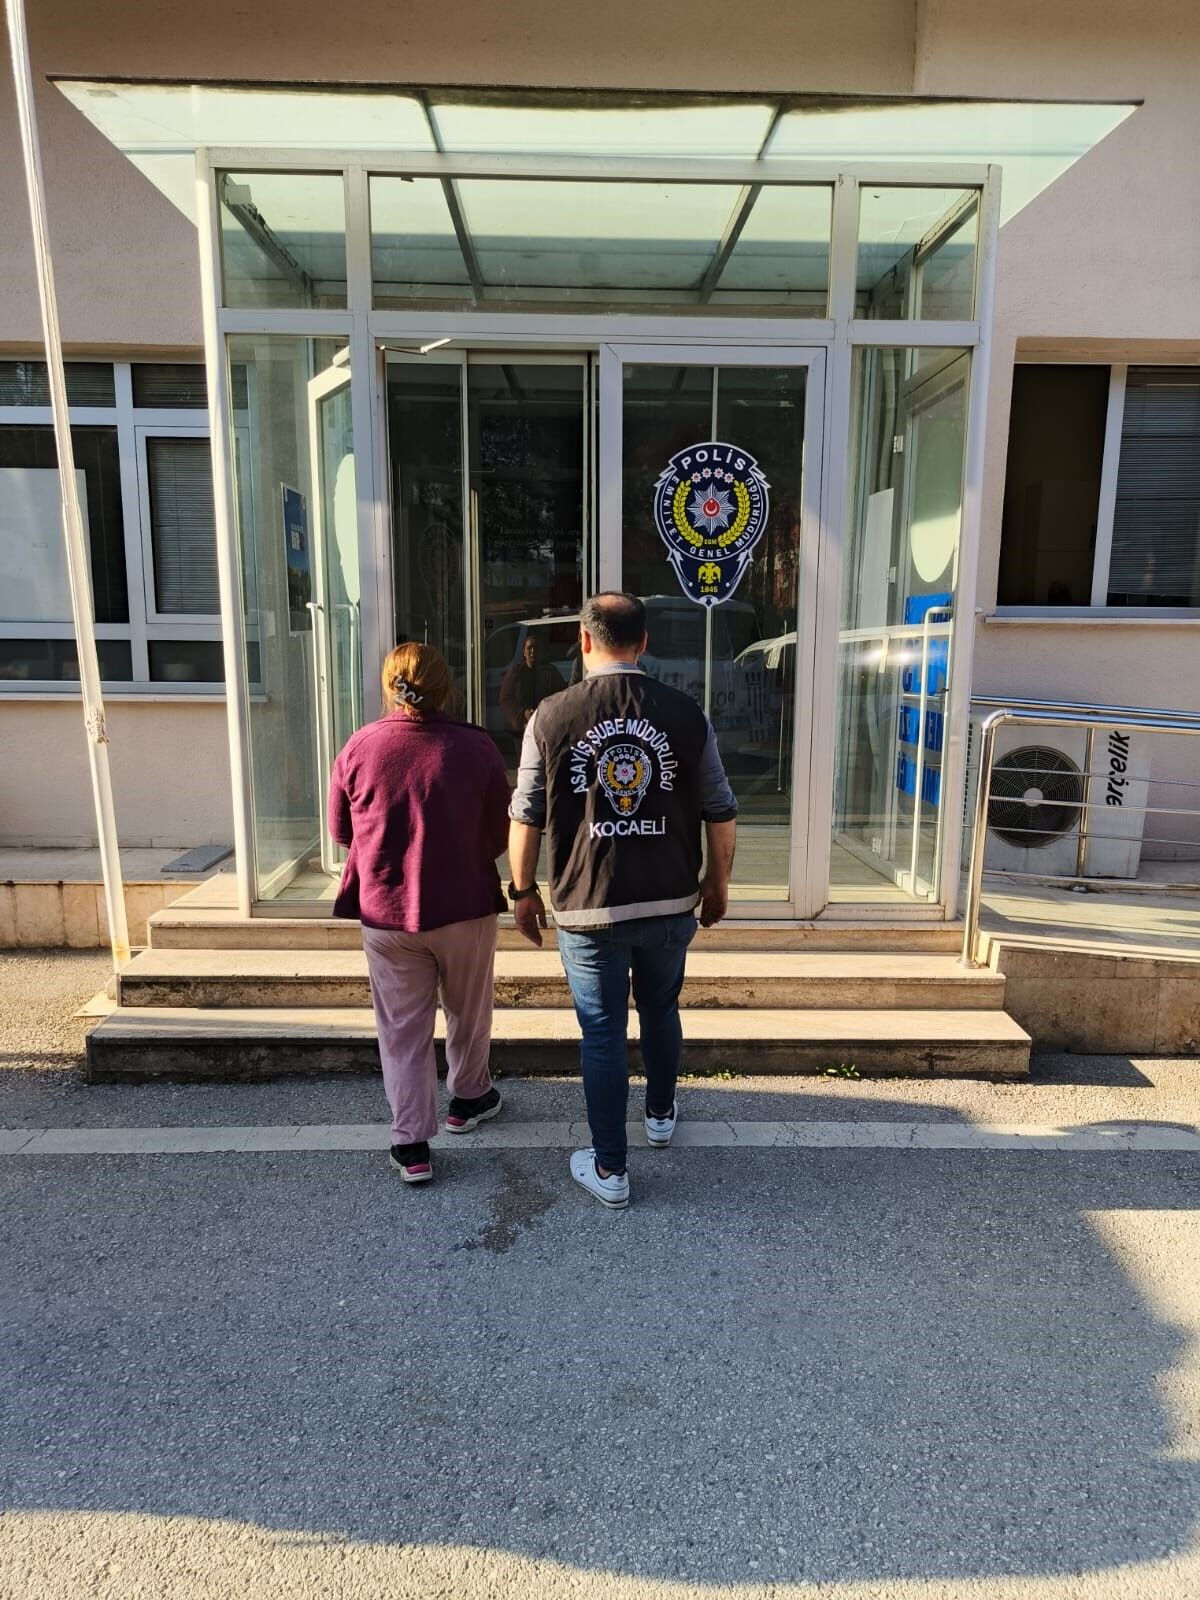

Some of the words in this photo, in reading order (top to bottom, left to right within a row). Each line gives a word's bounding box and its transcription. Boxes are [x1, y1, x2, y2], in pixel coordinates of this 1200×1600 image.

[681, 449, 746, 471] POLİS
[663, 476, 684, 543] EMNİYET
[690, 546, 731, 558] GENEL
[570, 740, 596, 794] ASAYİŞ
[586, 718, 625, 748] ŞUBE
[589, 816, 666, 839] KOCAELİ
